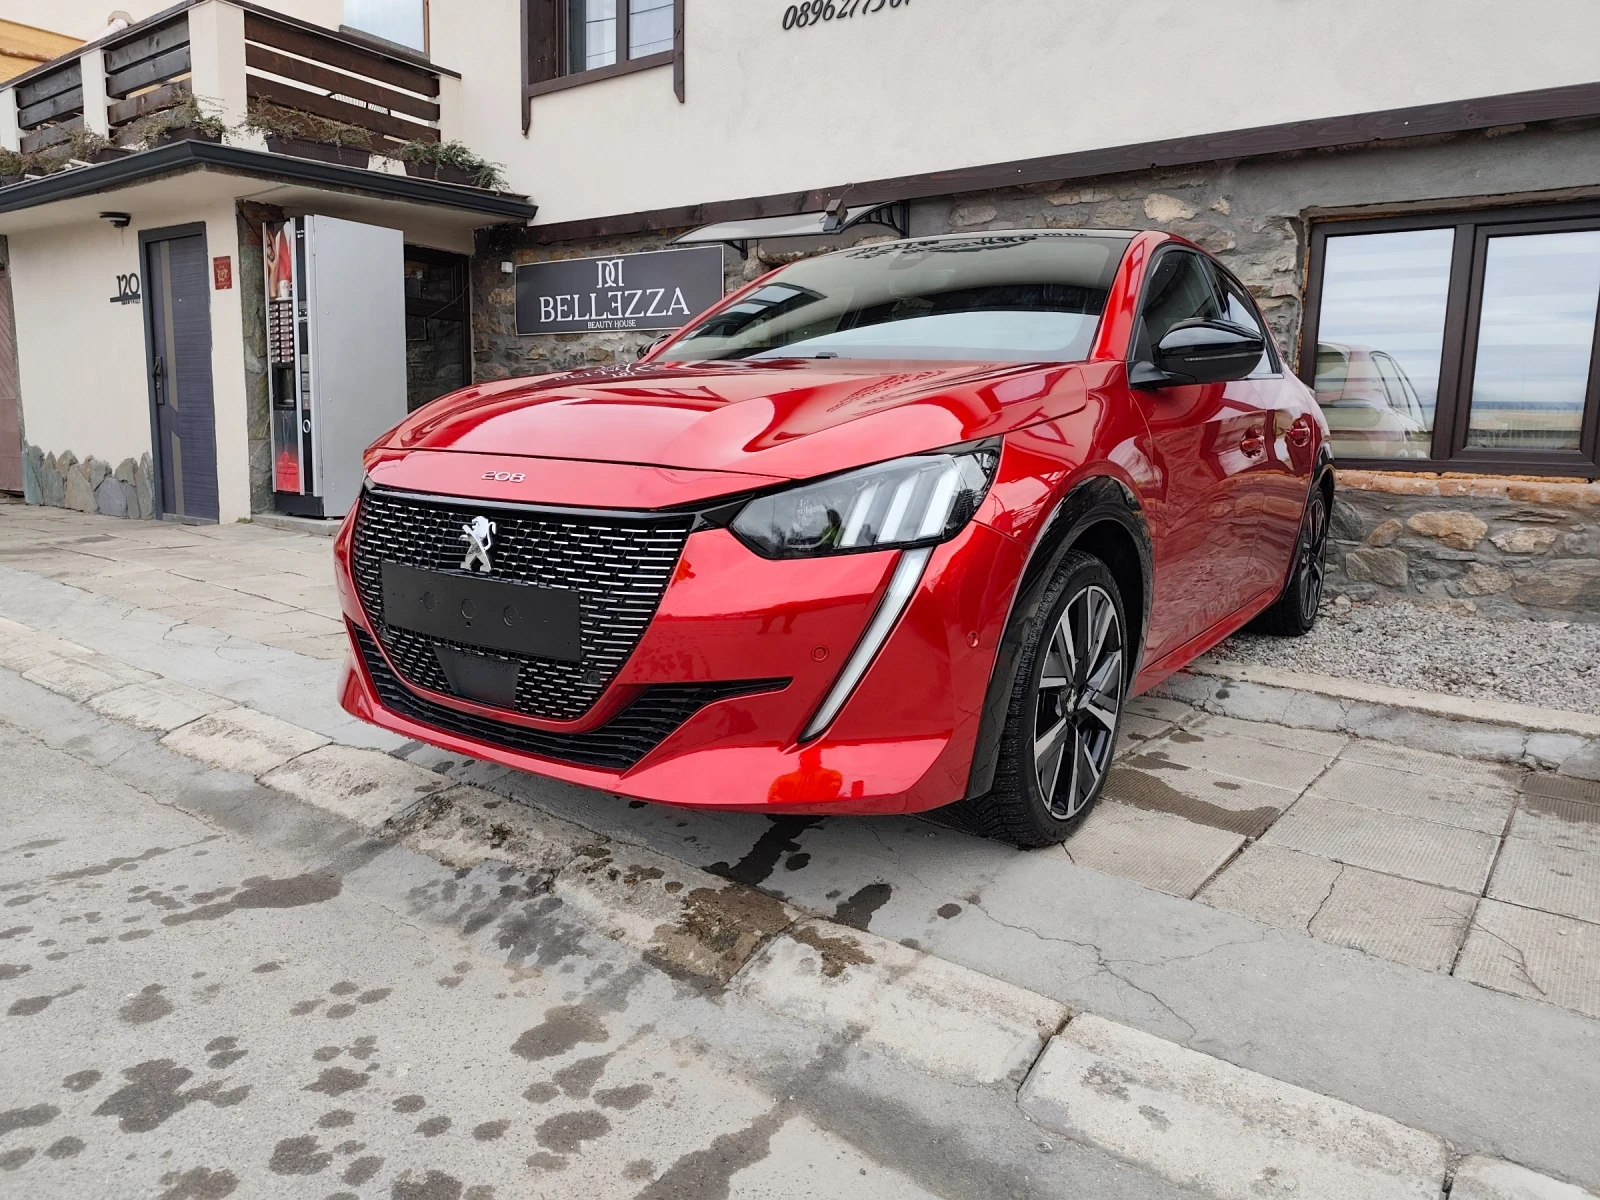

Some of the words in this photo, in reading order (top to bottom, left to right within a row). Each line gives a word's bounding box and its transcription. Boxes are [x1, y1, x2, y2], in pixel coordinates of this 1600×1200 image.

[116, 272, 140, 297] 120
[587, 320, 613, 329] BEAUTY
[614, 319, 637, 329] HOUSE
[481, 470, 526, 483] 208
